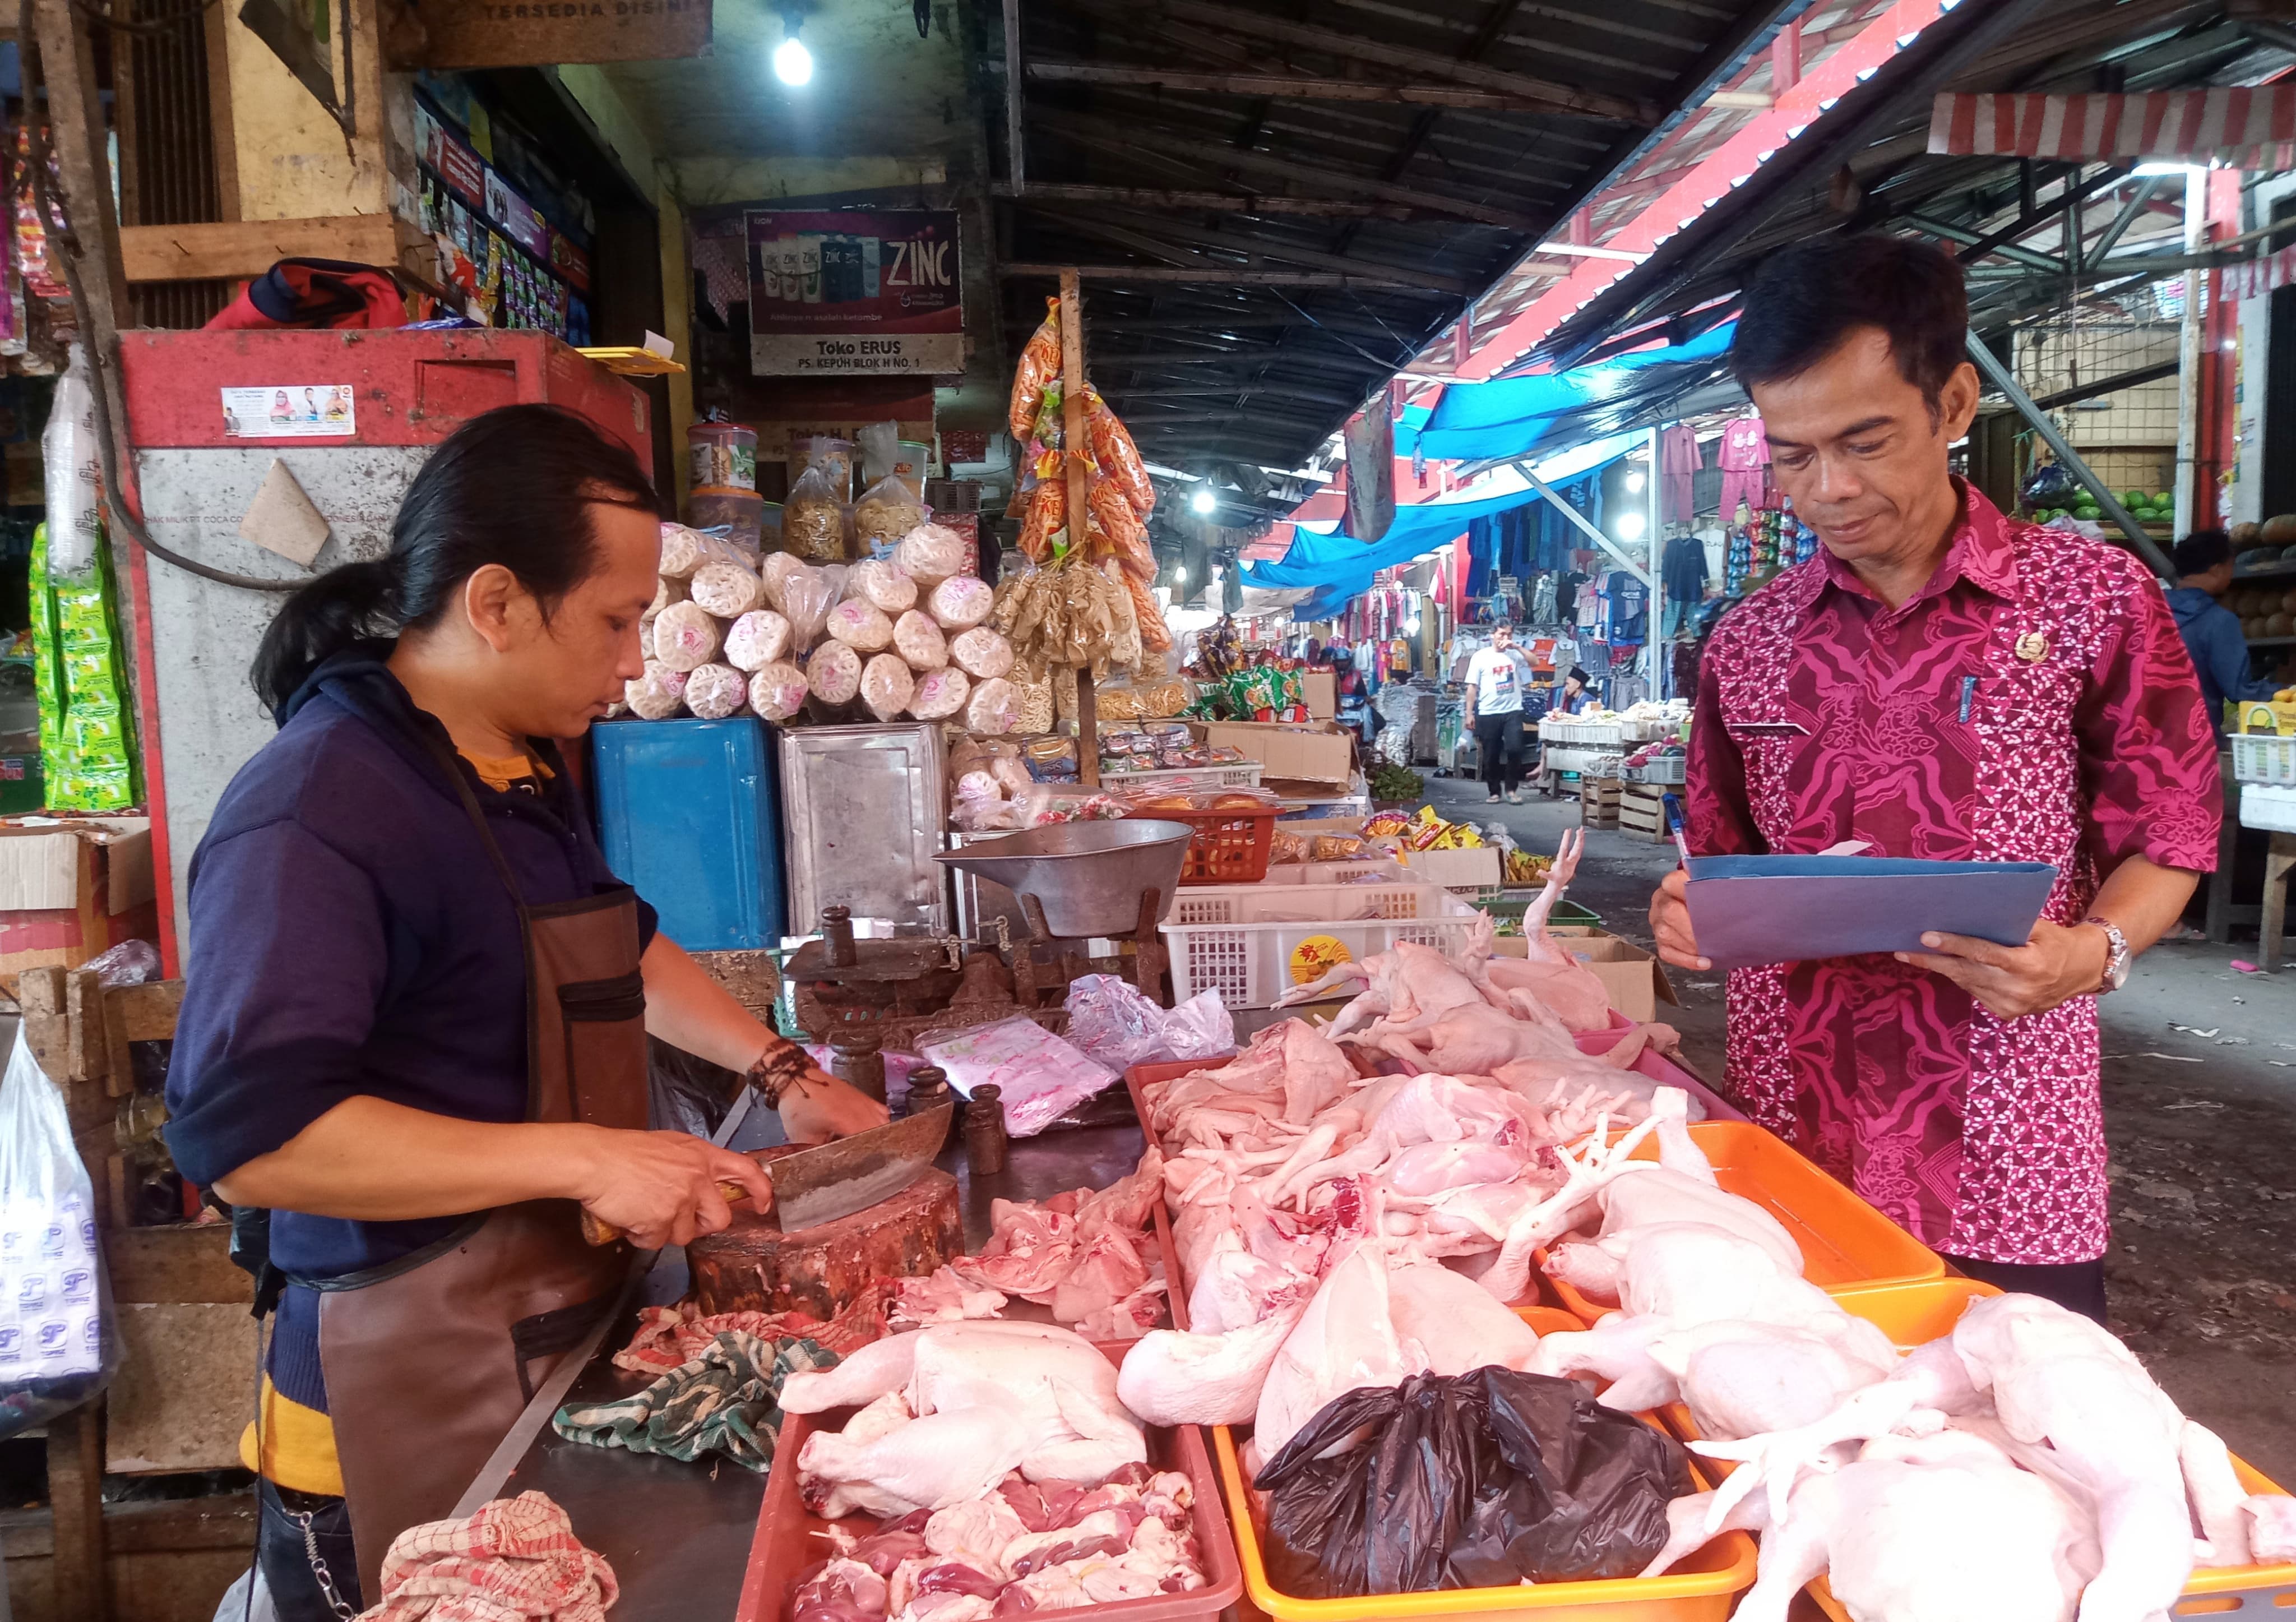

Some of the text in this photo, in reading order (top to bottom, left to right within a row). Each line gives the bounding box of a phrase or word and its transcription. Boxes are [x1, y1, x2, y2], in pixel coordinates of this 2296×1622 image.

[484, 2, 604, 20] TERSEDIA
[886, 239, 951, 286] ZINC
[816, 340, 901, 355] Toko ERUS
[817, 357, 850, 368] KEPUH
[854, 358, 879, 368] BLOK
[882, 358, 890, 368] H
[915, 358, 920, 367] 1
